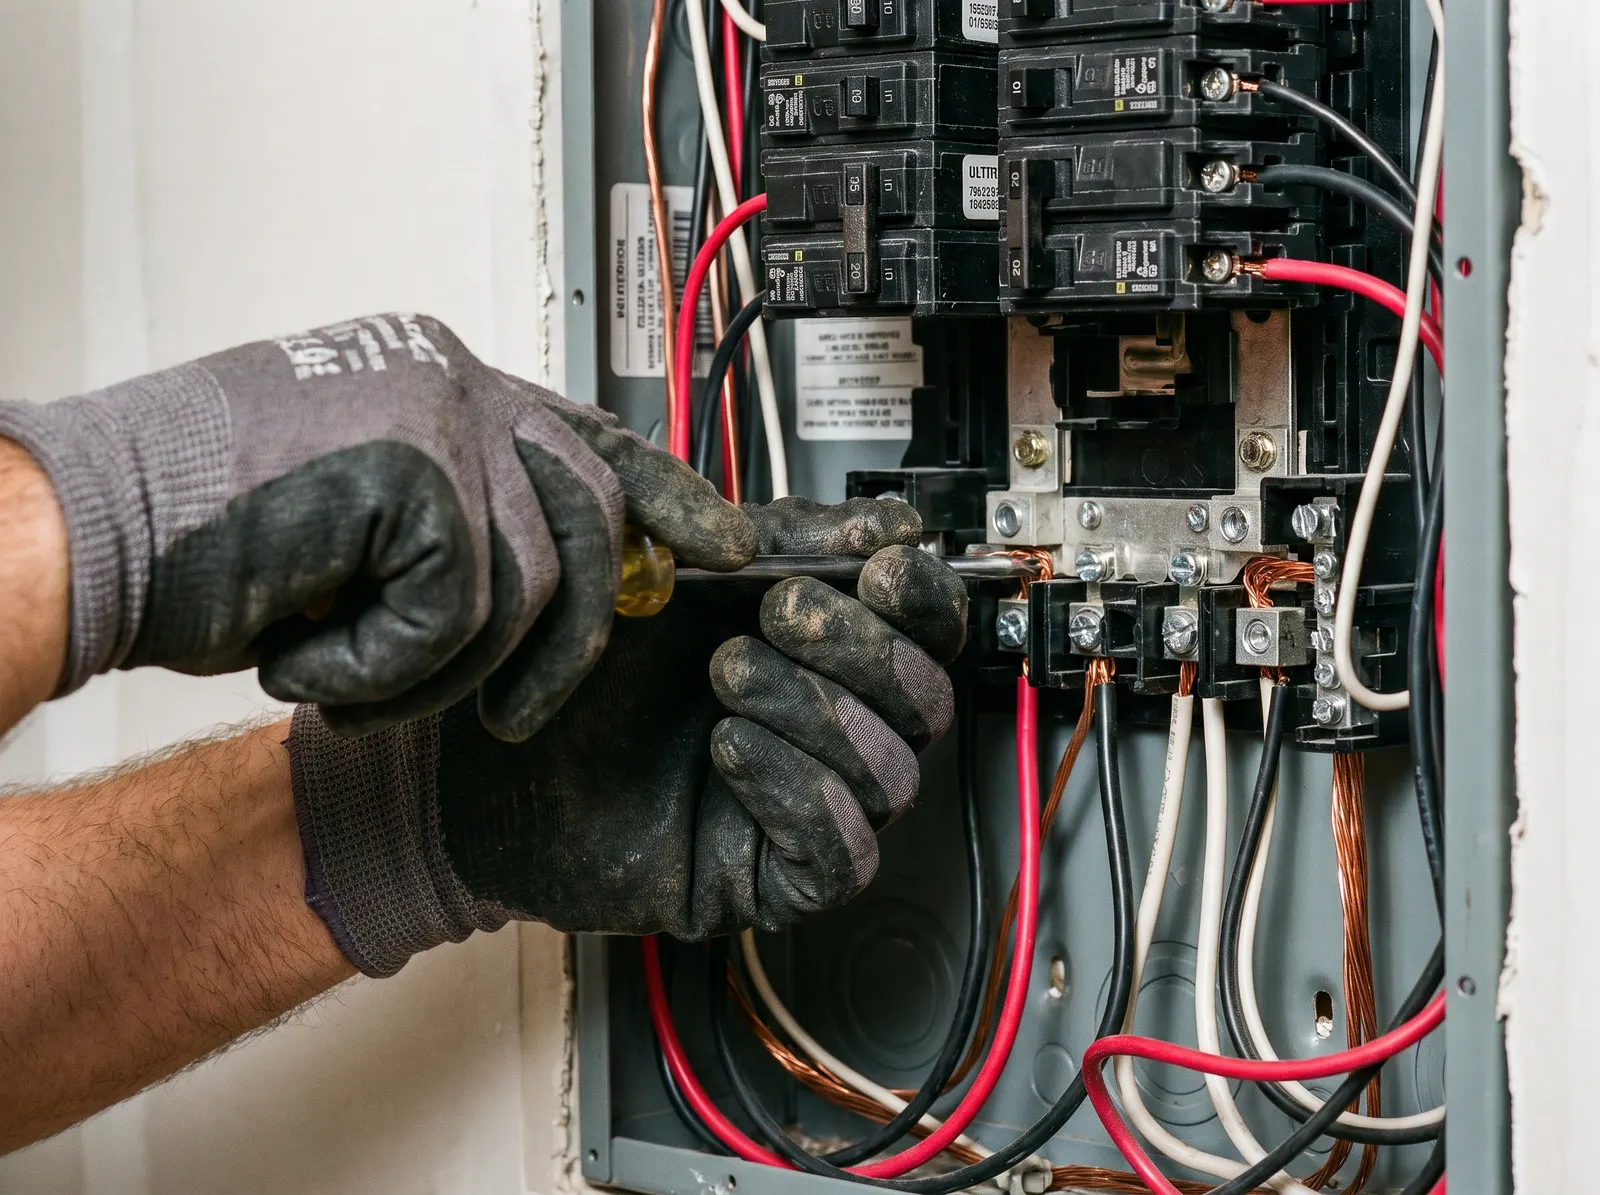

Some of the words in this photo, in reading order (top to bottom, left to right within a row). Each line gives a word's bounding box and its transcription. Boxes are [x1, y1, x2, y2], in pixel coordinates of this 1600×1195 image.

[1012, 81, 1021, 94] 10
[1011, 171, 1020, 187] 20
[850, 262, 861, 279] 20
[1012, 259, 1021, 277] 20
